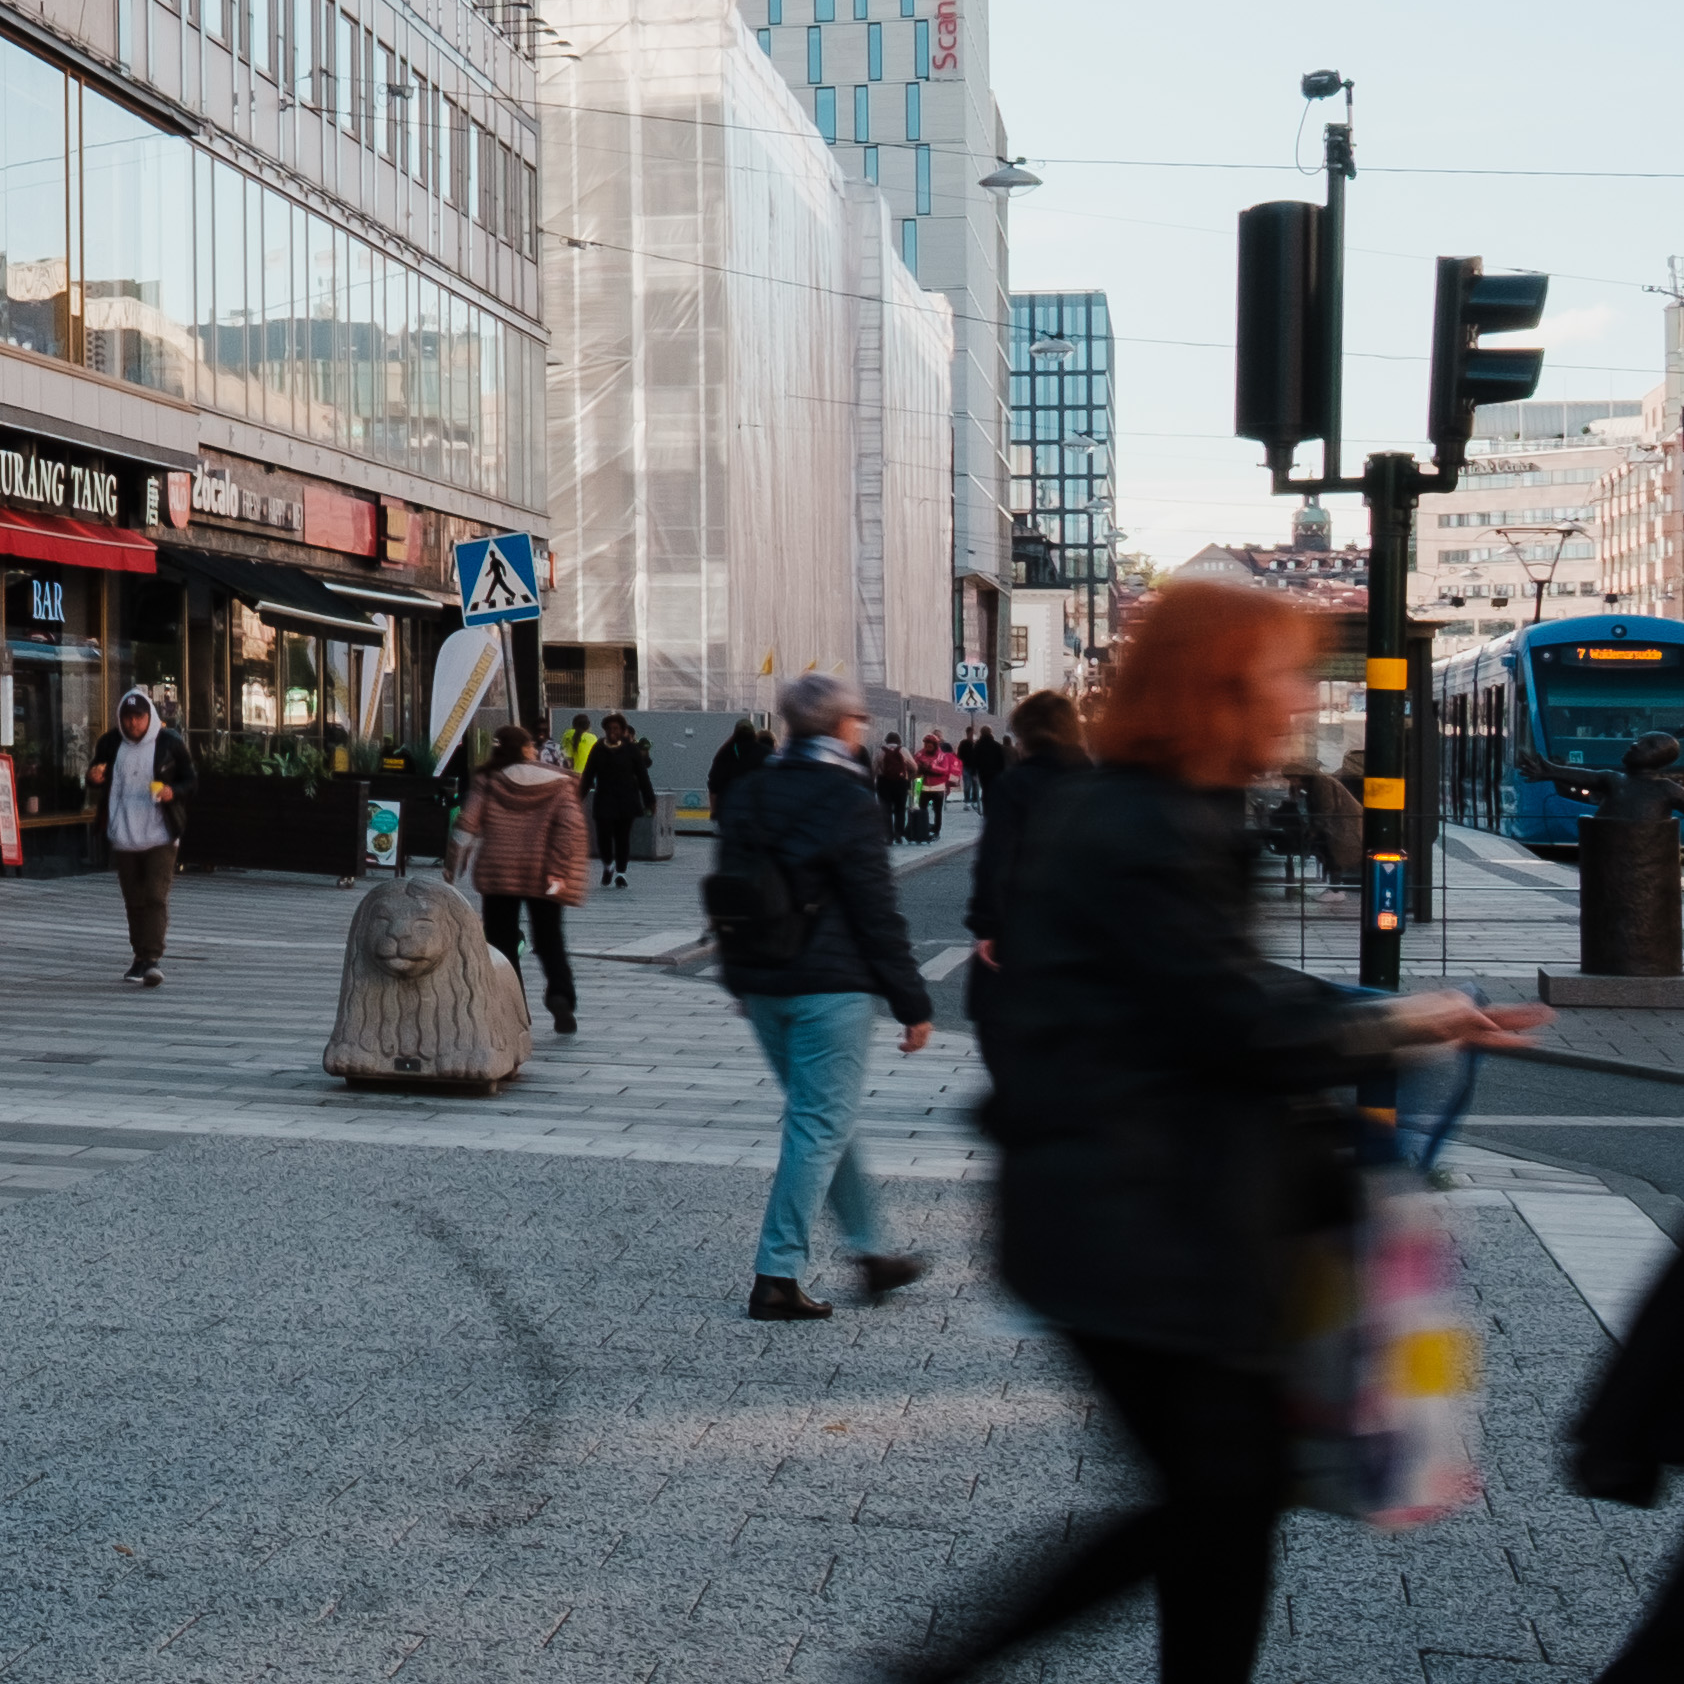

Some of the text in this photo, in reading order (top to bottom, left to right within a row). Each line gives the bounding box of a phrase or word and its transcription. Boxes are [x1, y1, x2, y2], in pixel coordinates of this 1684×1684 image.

[71, 464, 118, 517] TANG
[192, 459, 239, 518] Zócalo
[32, 579, 66, 623] BAR
[1577, 647, 1586, 661] 7
